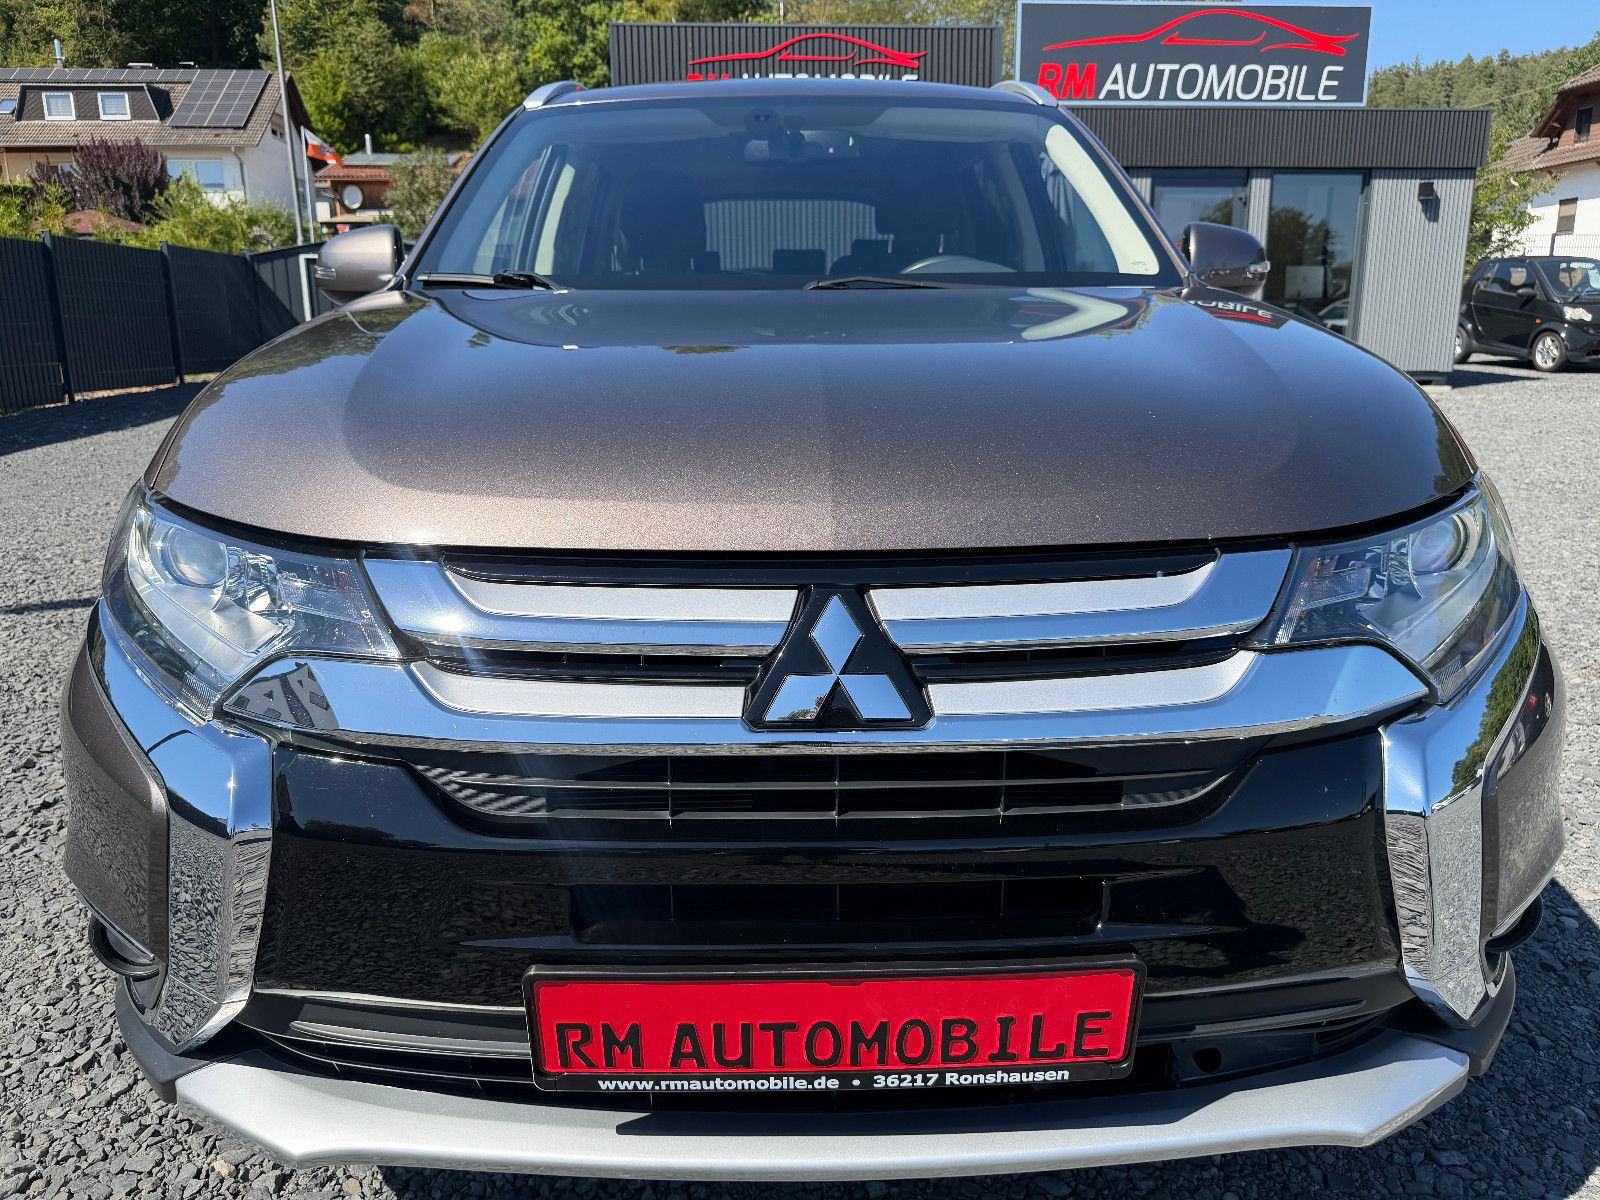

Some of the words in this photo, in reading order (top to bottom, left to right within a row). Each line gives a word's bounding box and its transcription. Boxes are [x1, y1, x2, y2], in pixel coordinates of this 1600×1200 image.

[1036, 62, 1098, 100] RM
[1097, 62, 1344, 101] AUTOMOBILE
[555, 1021, 646, 1069] RM
[669, 1011, 1112, 1069] AUTOMOBILE
[598, 1075, 839, 1091] www.rmautomobile.de
[873, 1073, 939, 1088] 36217
[945, 1069, 1070, 1085] Ronshausen
